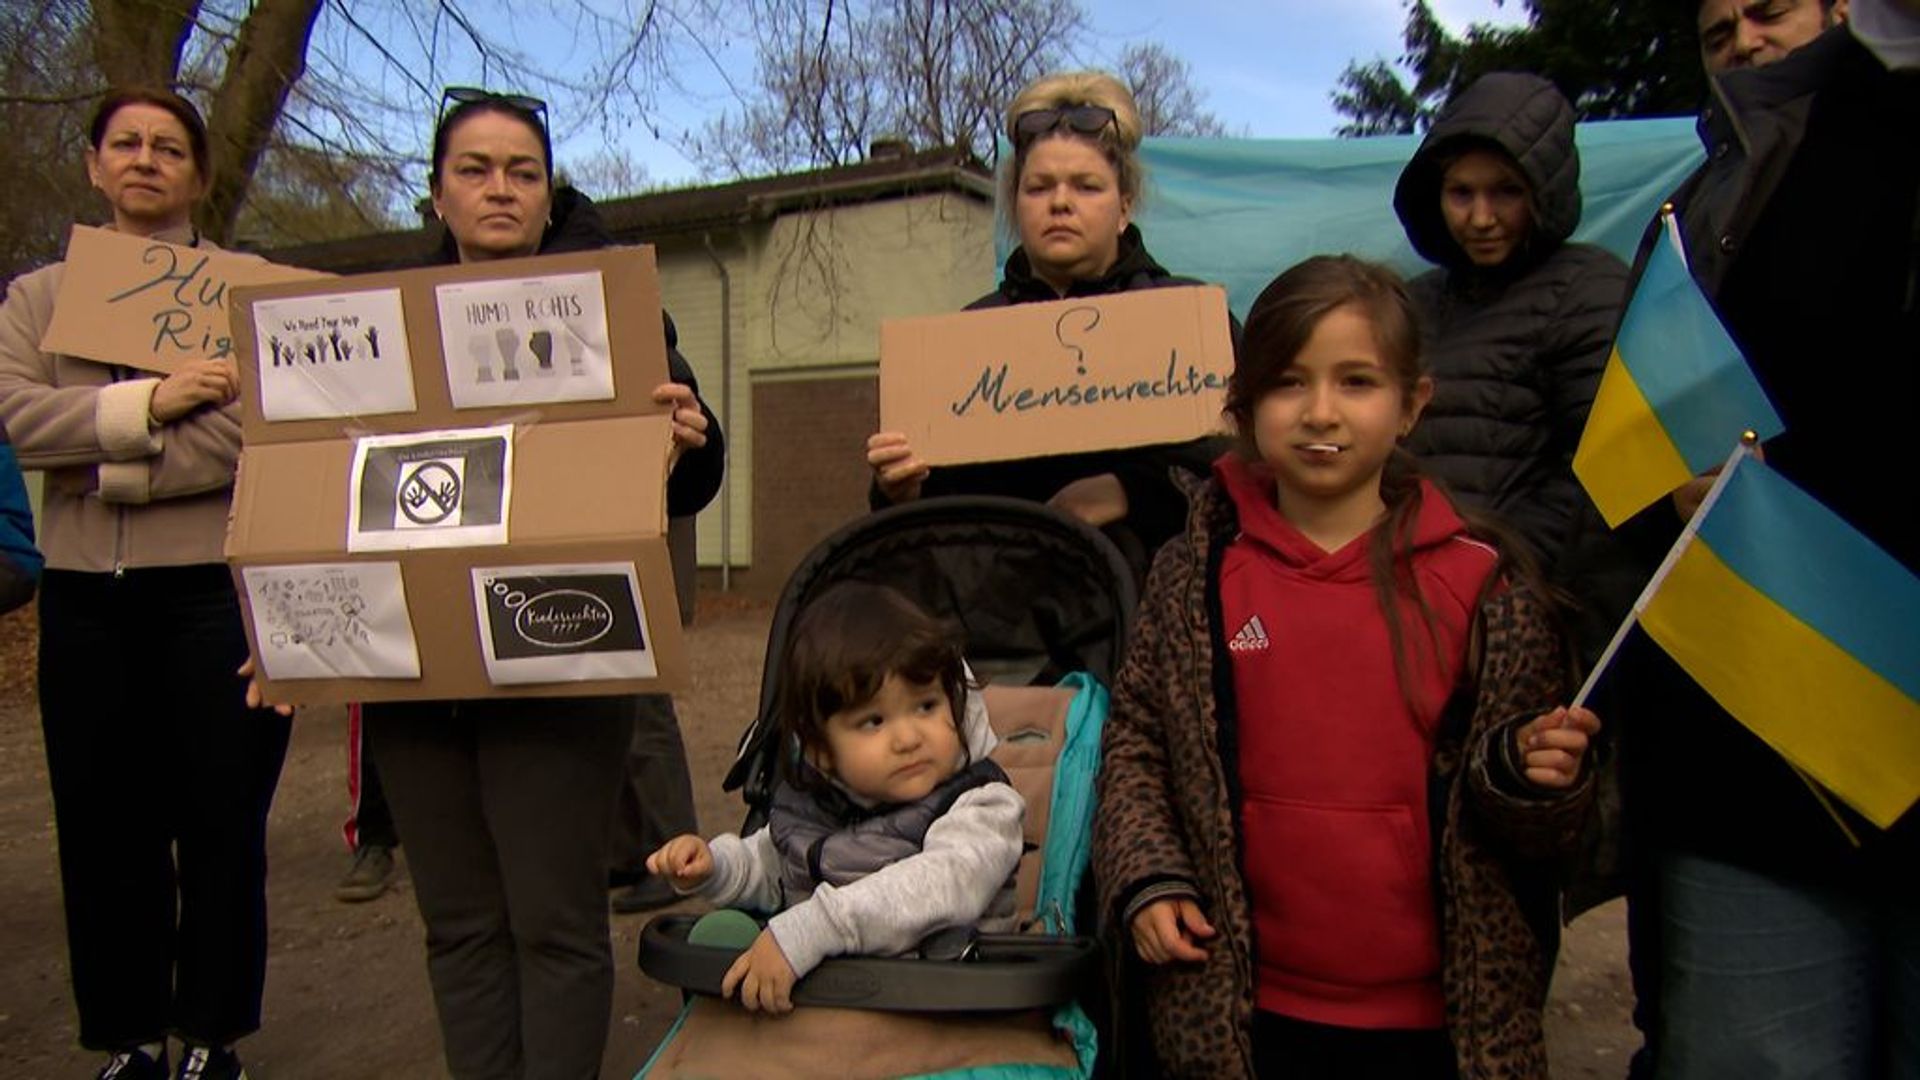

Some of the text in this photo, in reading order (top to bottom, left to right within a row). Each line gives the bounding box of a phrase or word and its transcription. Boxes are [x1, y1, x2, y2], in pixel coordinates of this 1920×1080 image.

[106, 245, 226, 309] Hu
[153, 308, 231, 359] Rig
[1055, 306, 1100, 375] ?
